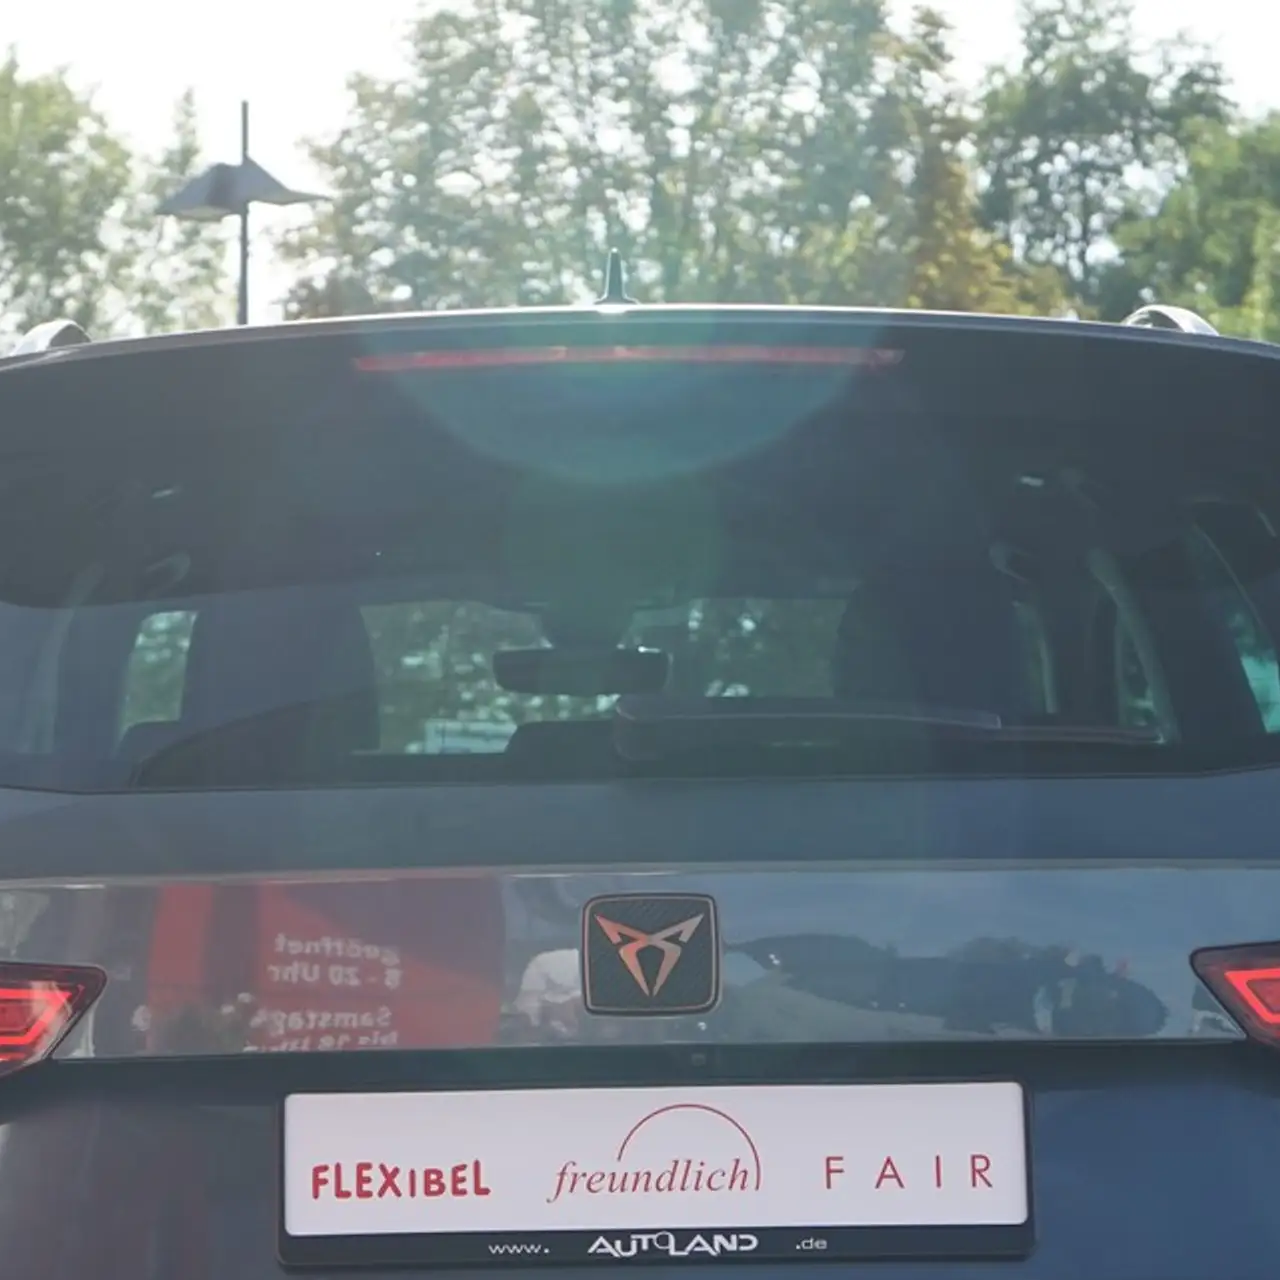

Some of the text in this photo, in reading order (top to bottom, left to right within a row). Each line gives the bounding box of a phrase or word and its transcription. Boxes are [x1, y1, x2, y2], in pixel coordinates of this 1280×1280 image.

[311, 1159, 491, 1200] FLEXIBEL
[546, 1157, 749, 1204] freundlich
[795, 1236, 828, 1251] .de
